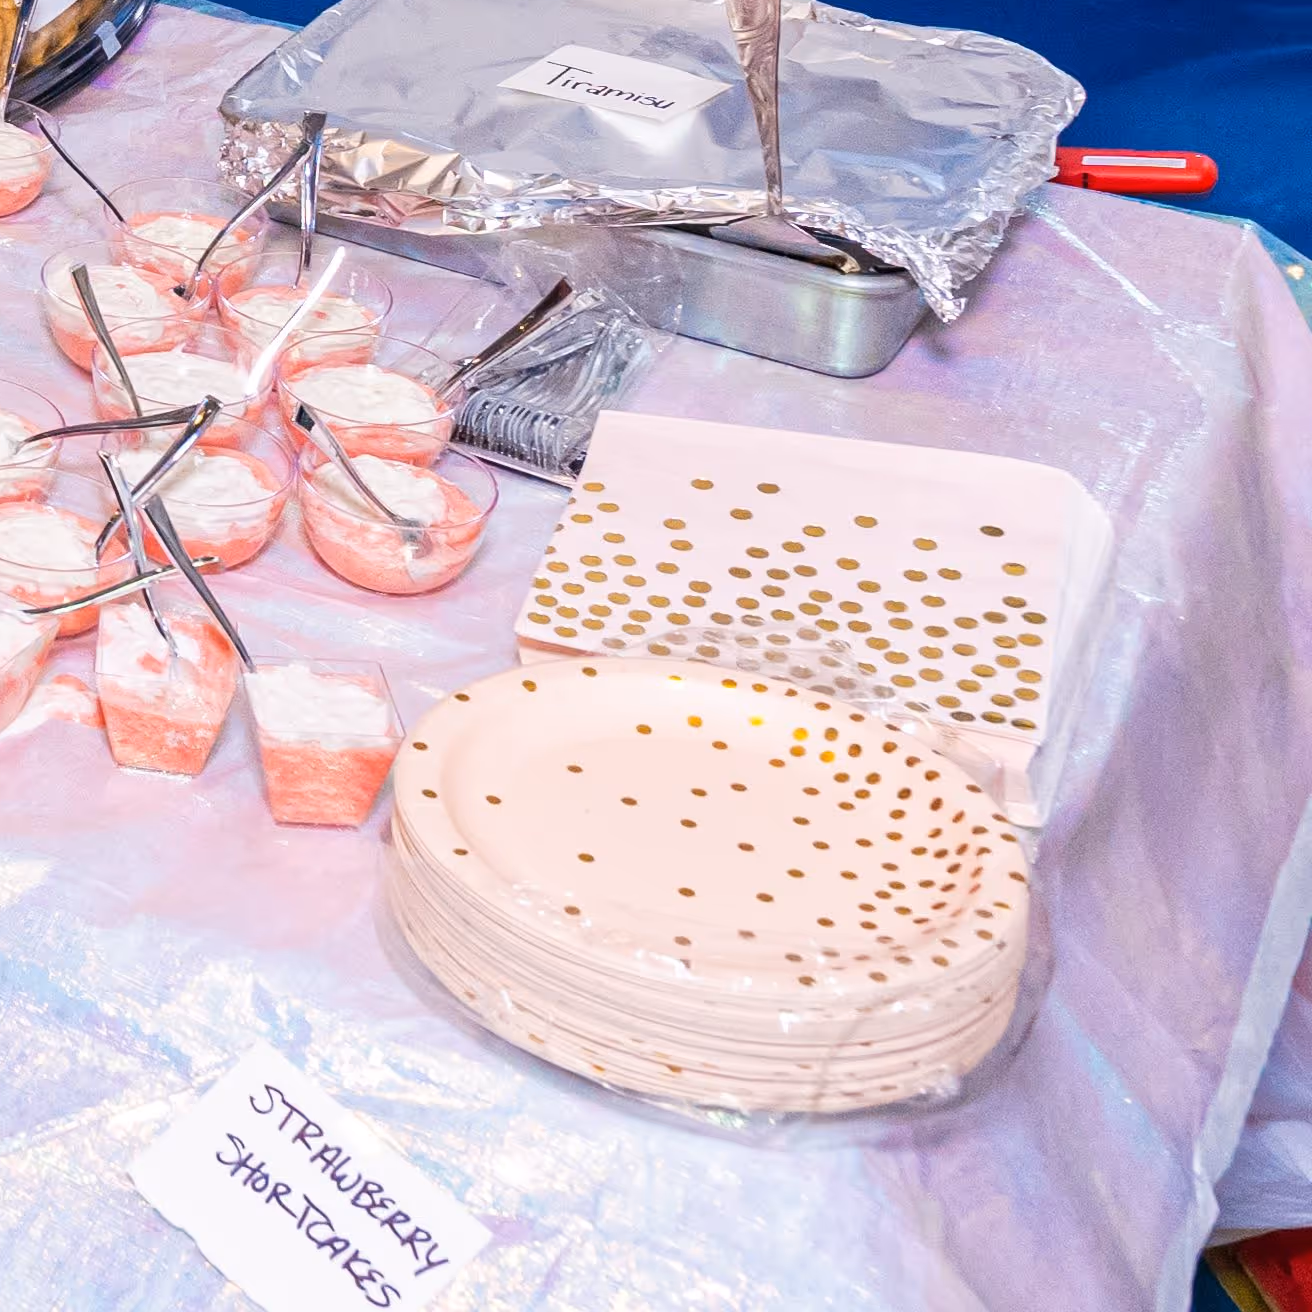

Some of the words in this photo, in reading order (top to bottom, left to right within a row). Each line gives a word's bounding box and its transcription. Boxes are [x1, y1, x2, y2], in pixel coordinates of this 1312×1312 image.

[546, 60, 675, 110] Tiramisu
[215, 1132, 401, 1308] SHORTCAKES
[249, 1084, 450, 1276] STRAWBERRY
